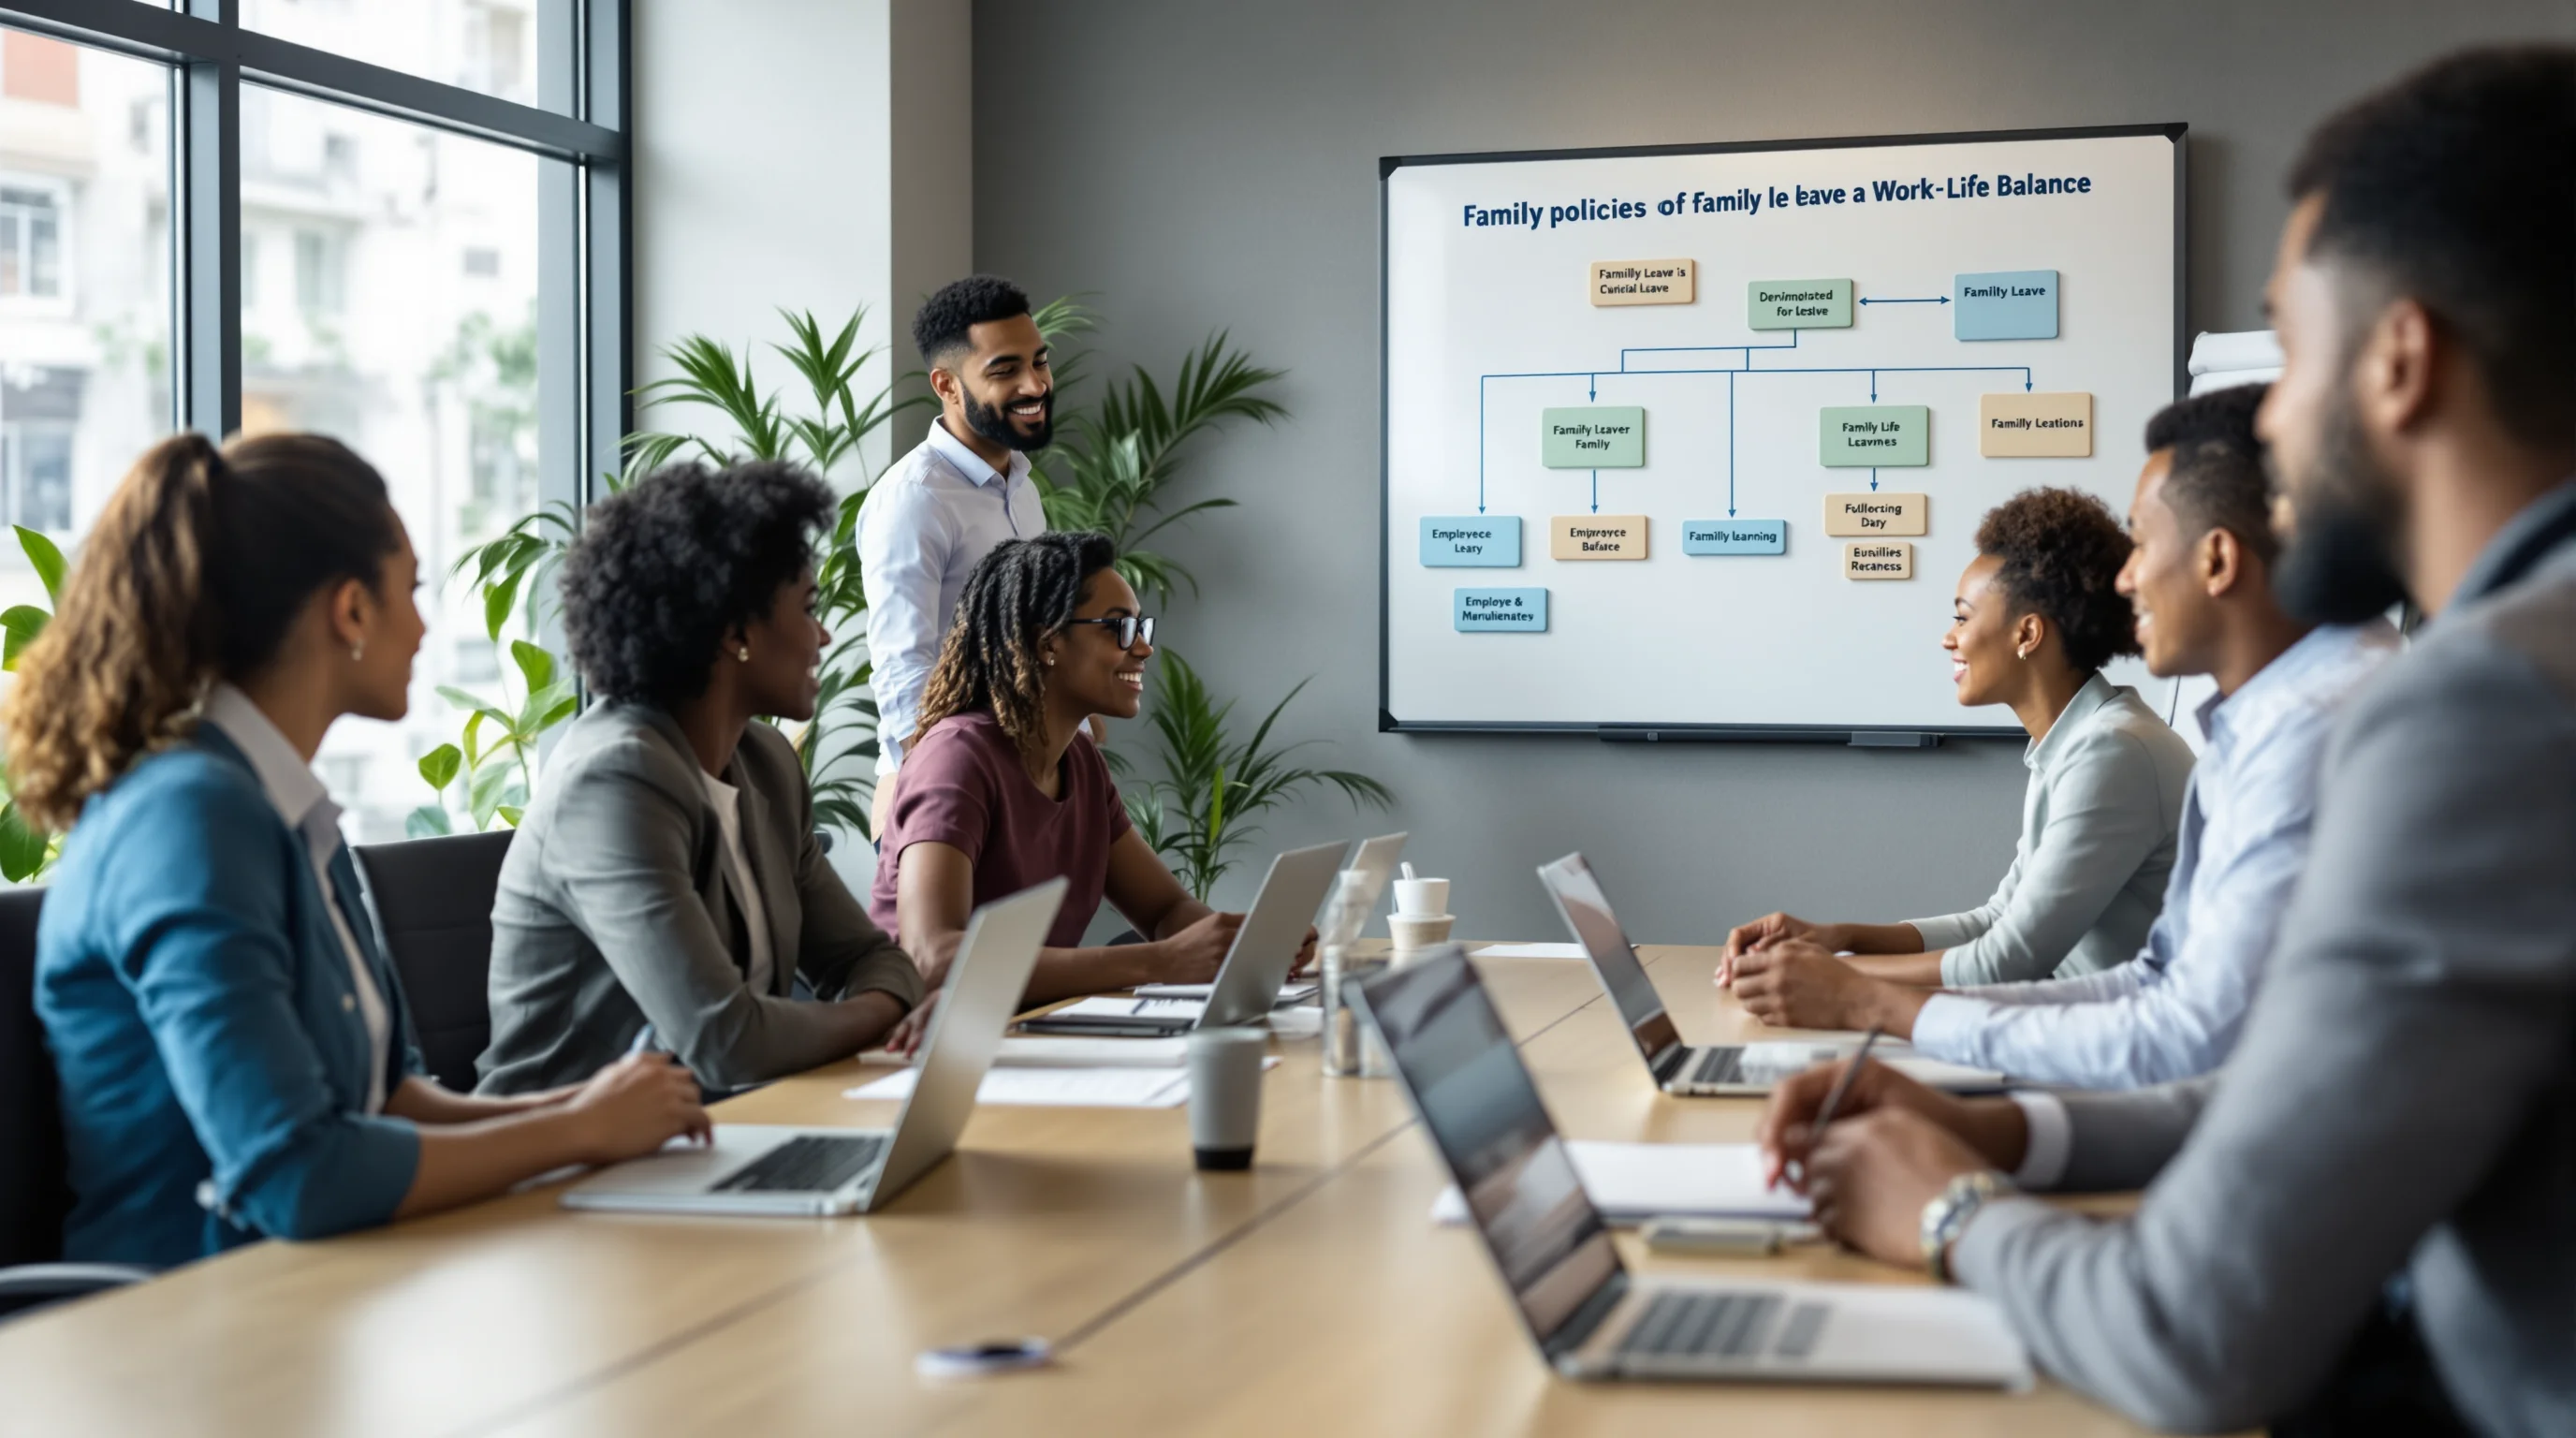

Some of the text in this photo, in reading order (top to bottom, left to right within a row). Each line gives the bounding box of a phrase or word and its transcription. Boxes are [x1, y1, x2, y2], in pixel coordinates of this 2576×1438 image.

[1463, 200, 1544, 230] Family
[1550, 198, 1647, 228] policies
[1658, 191, 1687, 216] of
[1852, 186, 1866, 203] a
[1871, 174, 1990, 202] Work-Life
[1997, 172, 2092, 197] Balance
[2011, 286, 2046, 297] Leave
[1777, 306, 1793, 317] for
[1514, 596, 1524, 608] &
